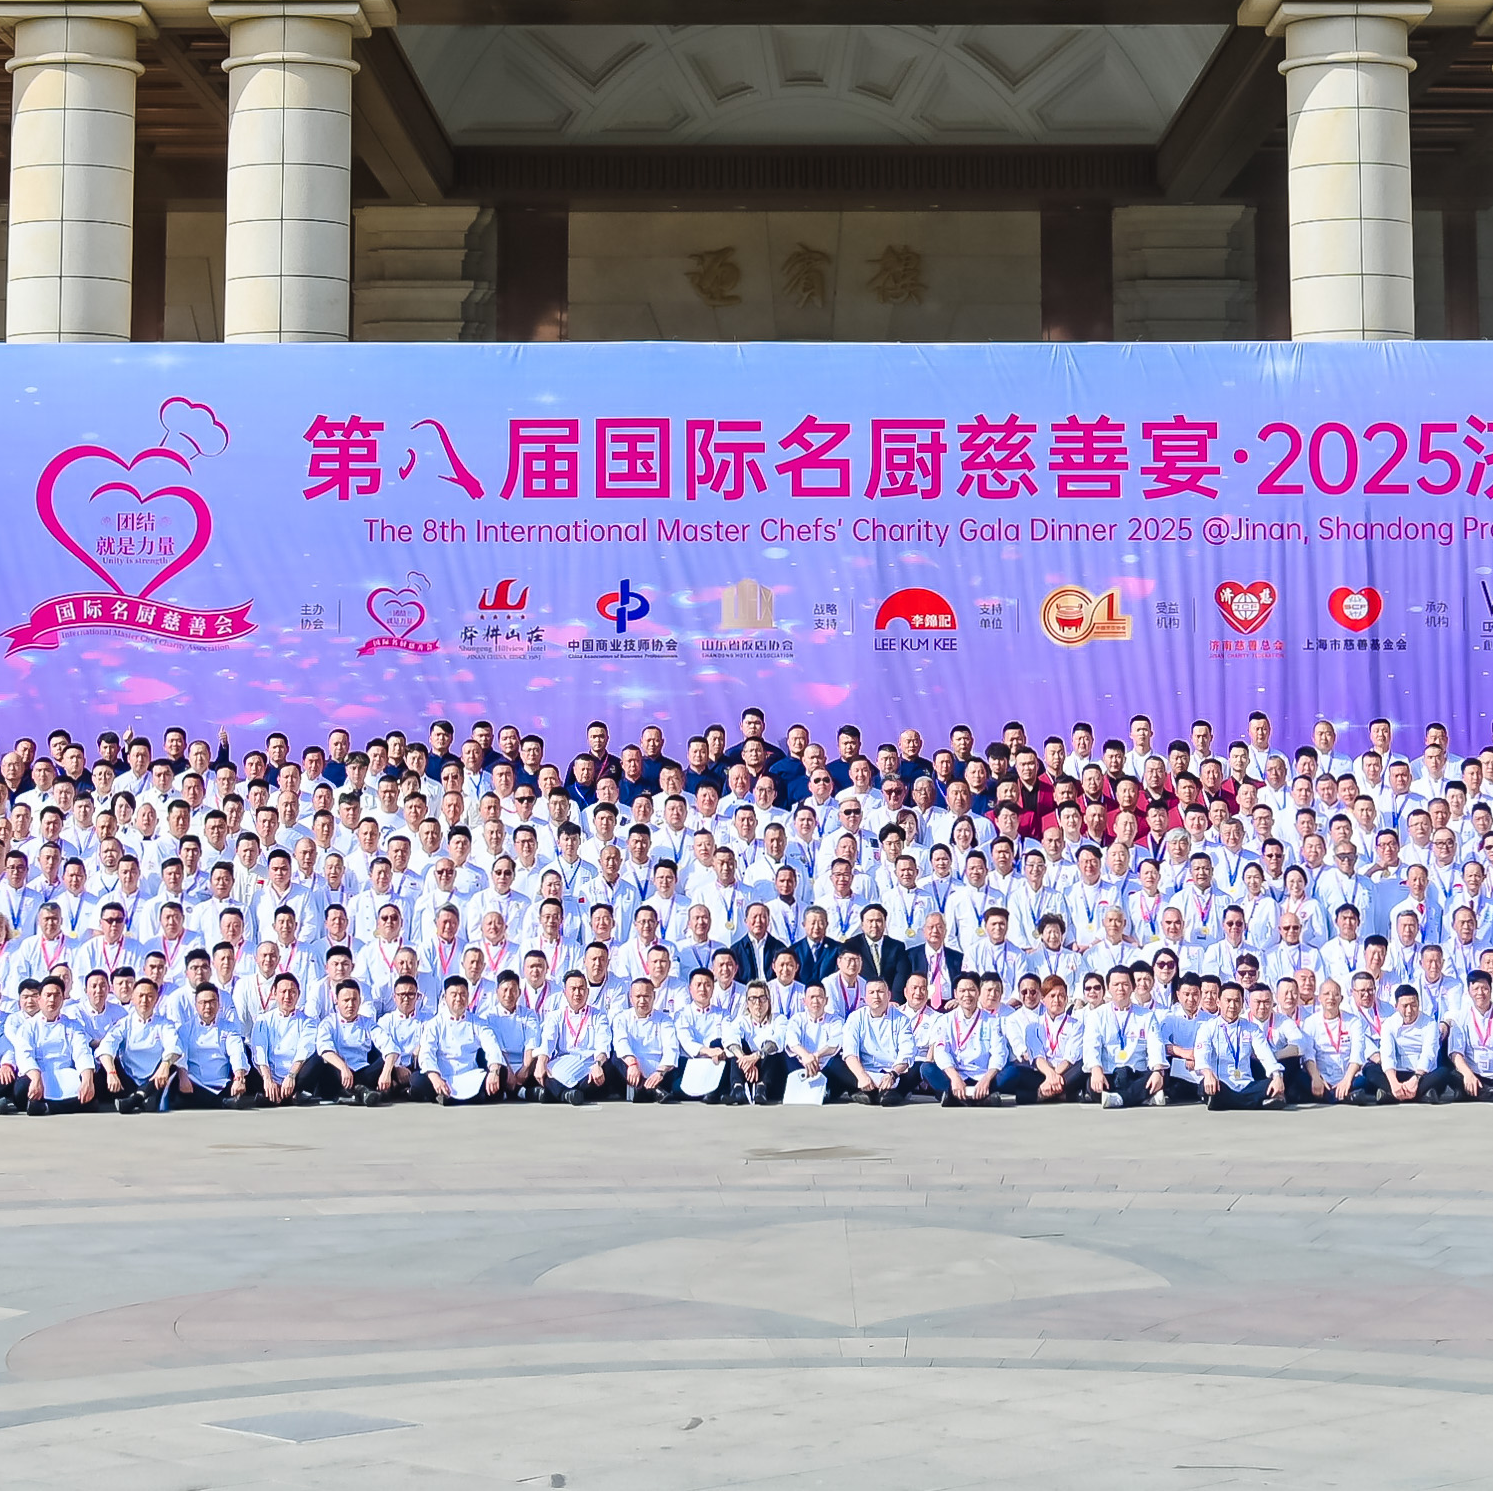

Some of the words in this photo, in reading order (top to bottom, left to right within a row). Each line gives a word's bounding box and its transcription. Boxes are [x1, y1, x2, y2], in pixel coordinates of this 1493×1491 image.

[117, 512, 155, 531] 团结
[364, 518, 412, 542] The
[422, 518, 466, 542] 8th
[476, 518, 646, 542] International
[657, 518, 749, 542] Master
[761, 517, 843, 542] Chefs'
[853, 517, 950, 547] Charity
[960, 517, 1020, 542] Gala
[1031, 517, 1117, 541] Dinner
[1128, 517, 1193, 541] 2025
[1202, 516, 1310, 546] @Jinan,
[1318, 516, 1453, 546] Shandong
[96, 536, 175, 556] 就是力量
[102, 557, 124, 566] Unity
[301, 604, 324, 615] 主办
[814, 604, 837, 615] 战略
[979, 604, 1002, 615] 支持
[1156, 602, 1179, 614] 受益
[1426, 602, 1448, 613] 承办
[55, 599, 233, 635] 国际名厨慈善会
[1426, 616, 1449, 627] 机构
[301, 618, 324, 629] 协会
[814, 619, 837, 630] 支持
[980, 618, 1002, 629] 单位
[1157, 617, 1180, 629] 机构
[568, 639, 678, 652] 中国商业技师协会
[875, 638, 896, 650] LEE
[901, 638, 928, 650] KUM
[934, 638, 957, 650] KEE
[1303, 639, 1407, 650] 上海市慈善基金会
